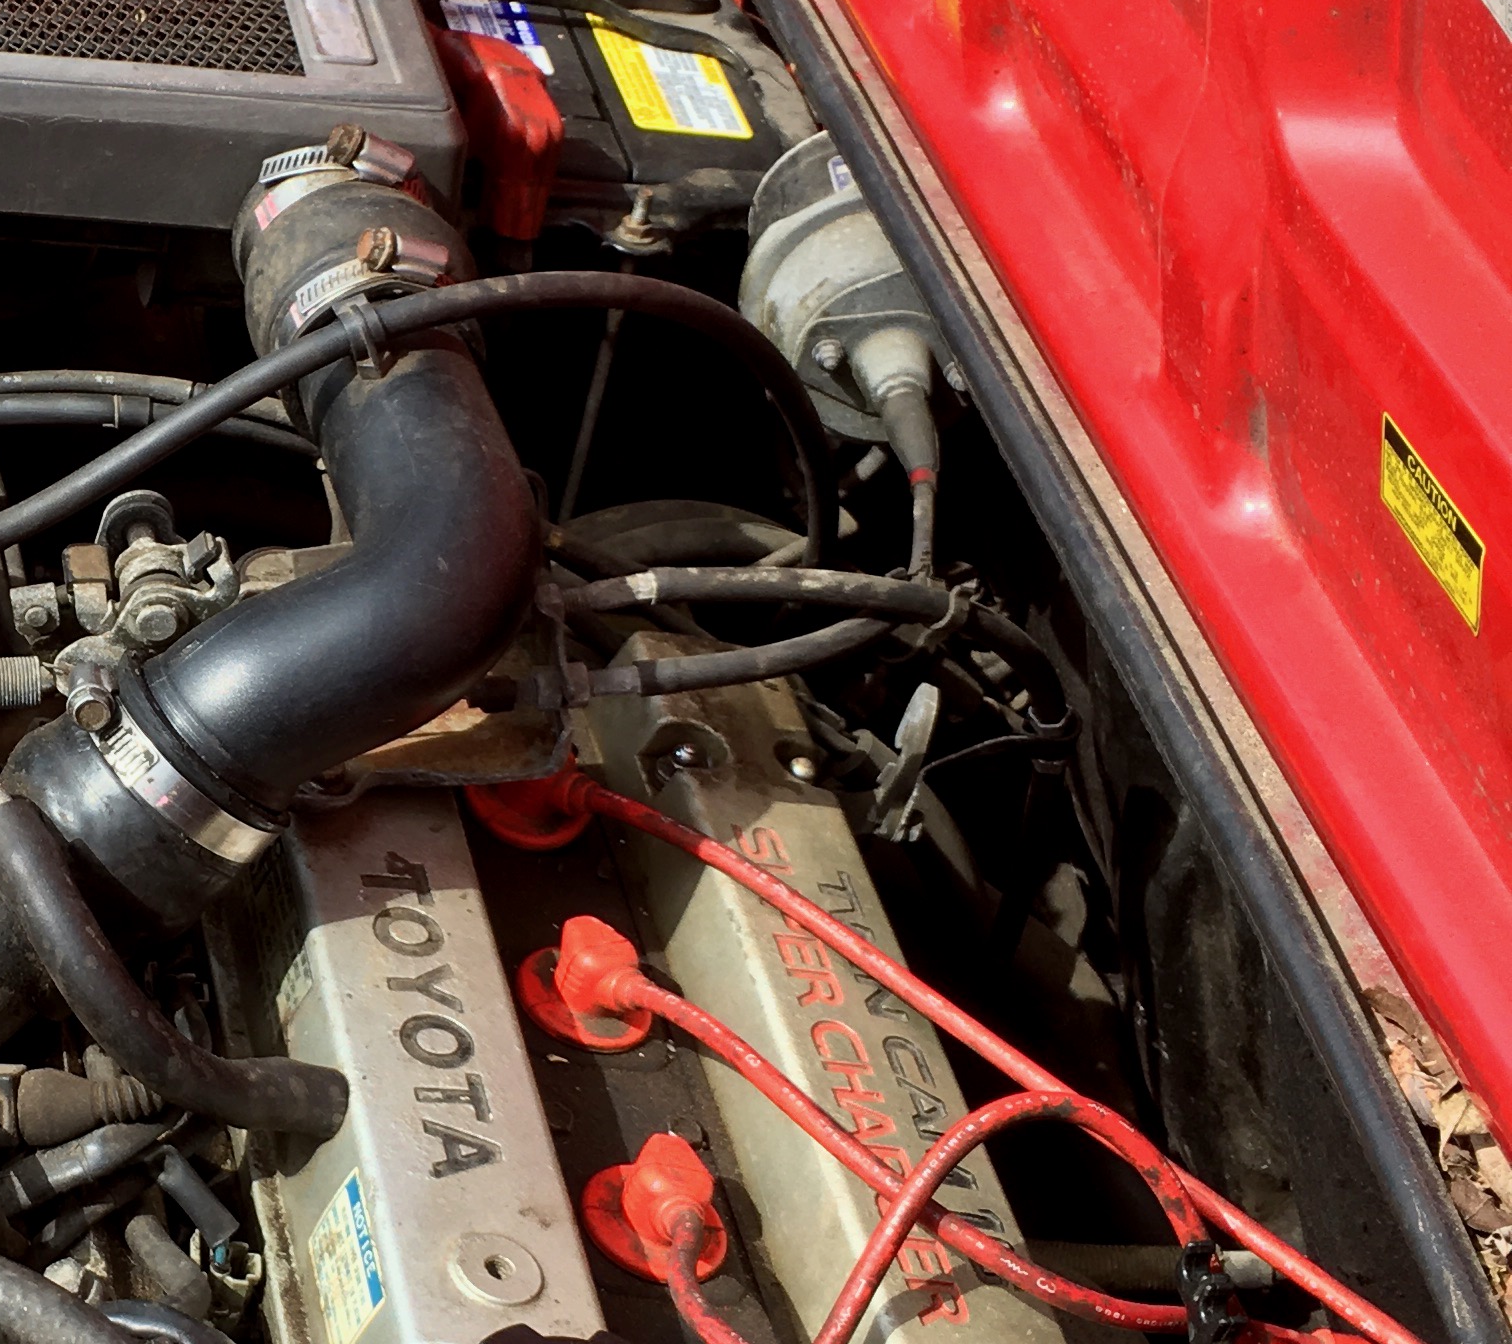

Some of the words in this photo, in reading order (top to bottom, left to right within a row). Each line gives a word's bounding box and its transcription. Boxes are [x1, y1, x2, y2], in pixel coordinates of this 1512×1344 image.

[1406, 453, 1458, 533] CAUTION
[360, 852, 503, 1179] TOYOTA
[352, 1201, 377, 1278] NOTICE
